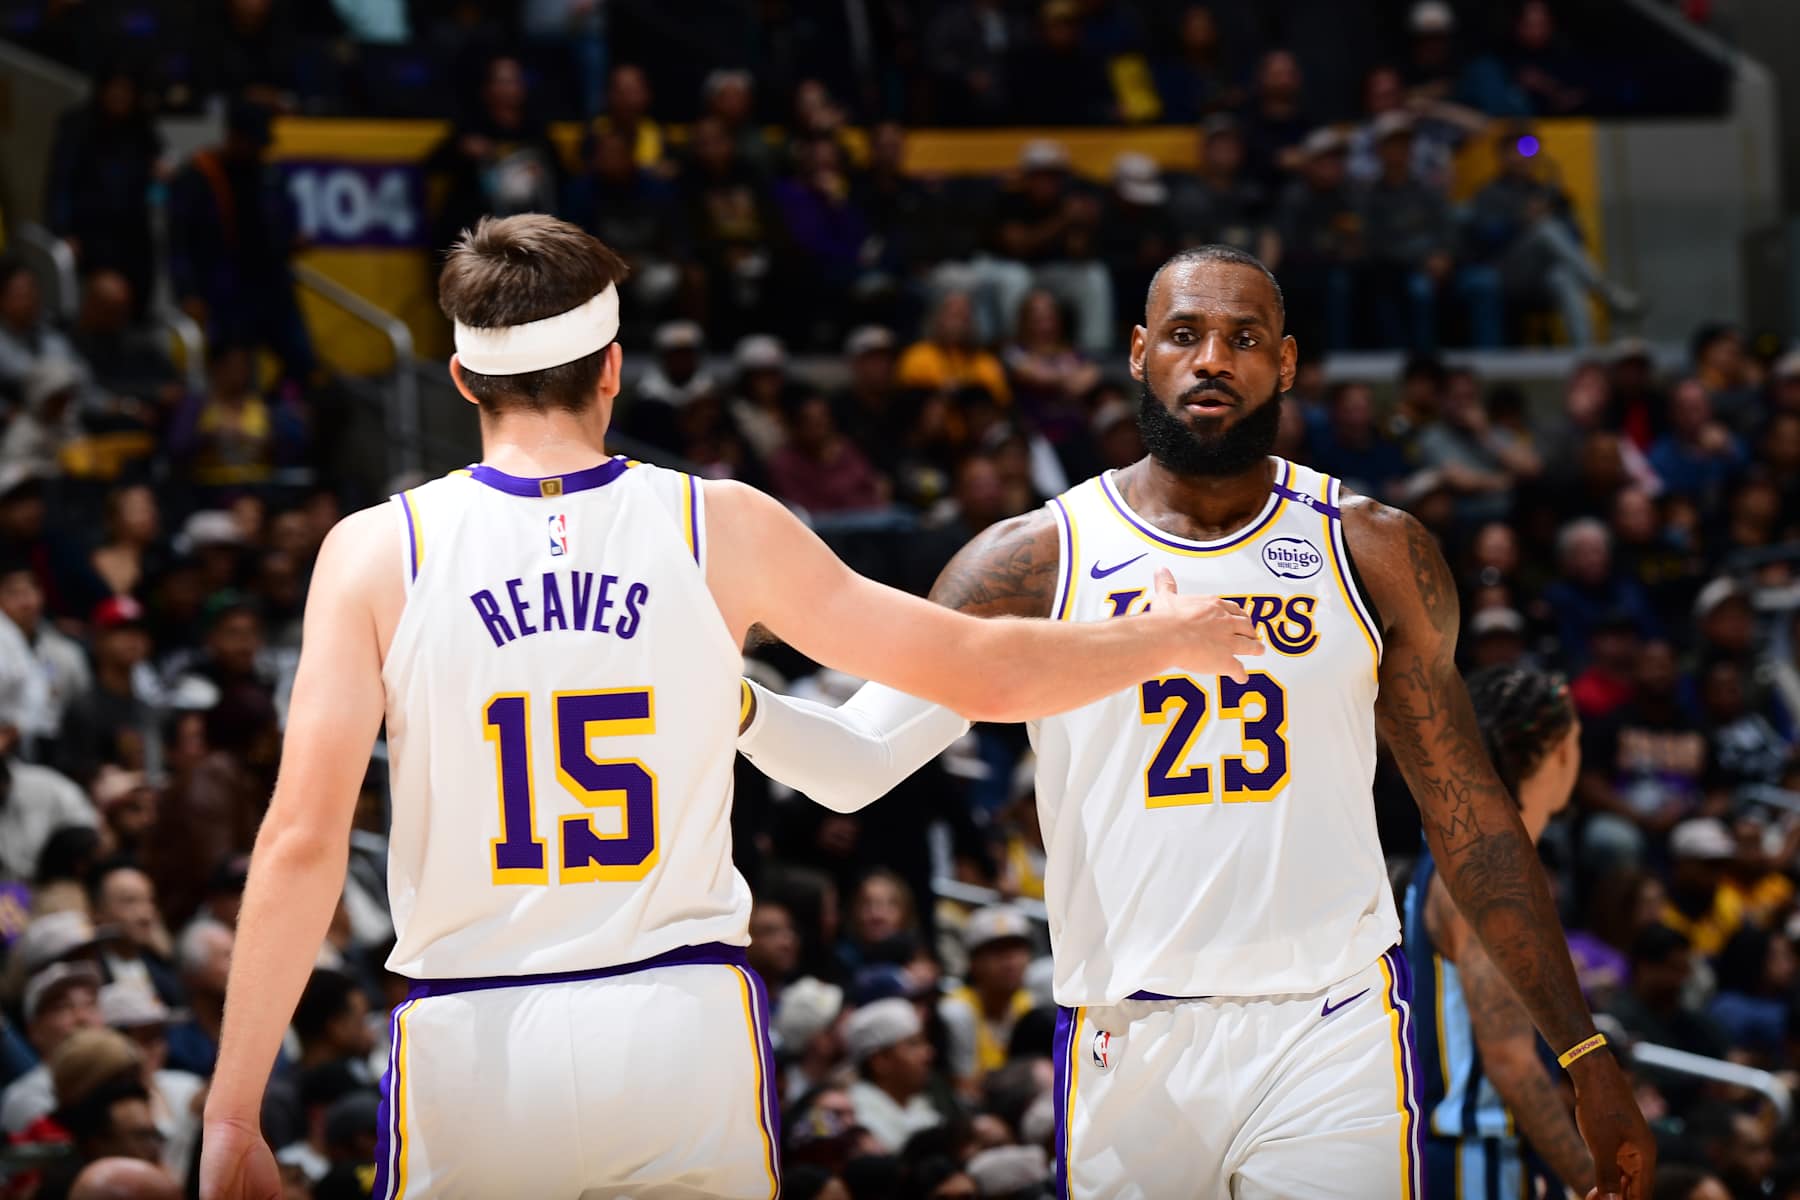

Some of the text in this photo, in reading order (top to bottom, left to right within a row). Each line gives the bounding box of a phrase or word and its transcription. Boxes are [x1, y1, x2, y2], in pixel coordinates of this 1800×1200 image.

[288, 170, 416, 239] 104
[1268, 547, 1319, 567] bibigo
[470, 571, 649, 648] REAVES
[1138, 669, 1291, 809] 23
[481, 686, 660, 886] 15
